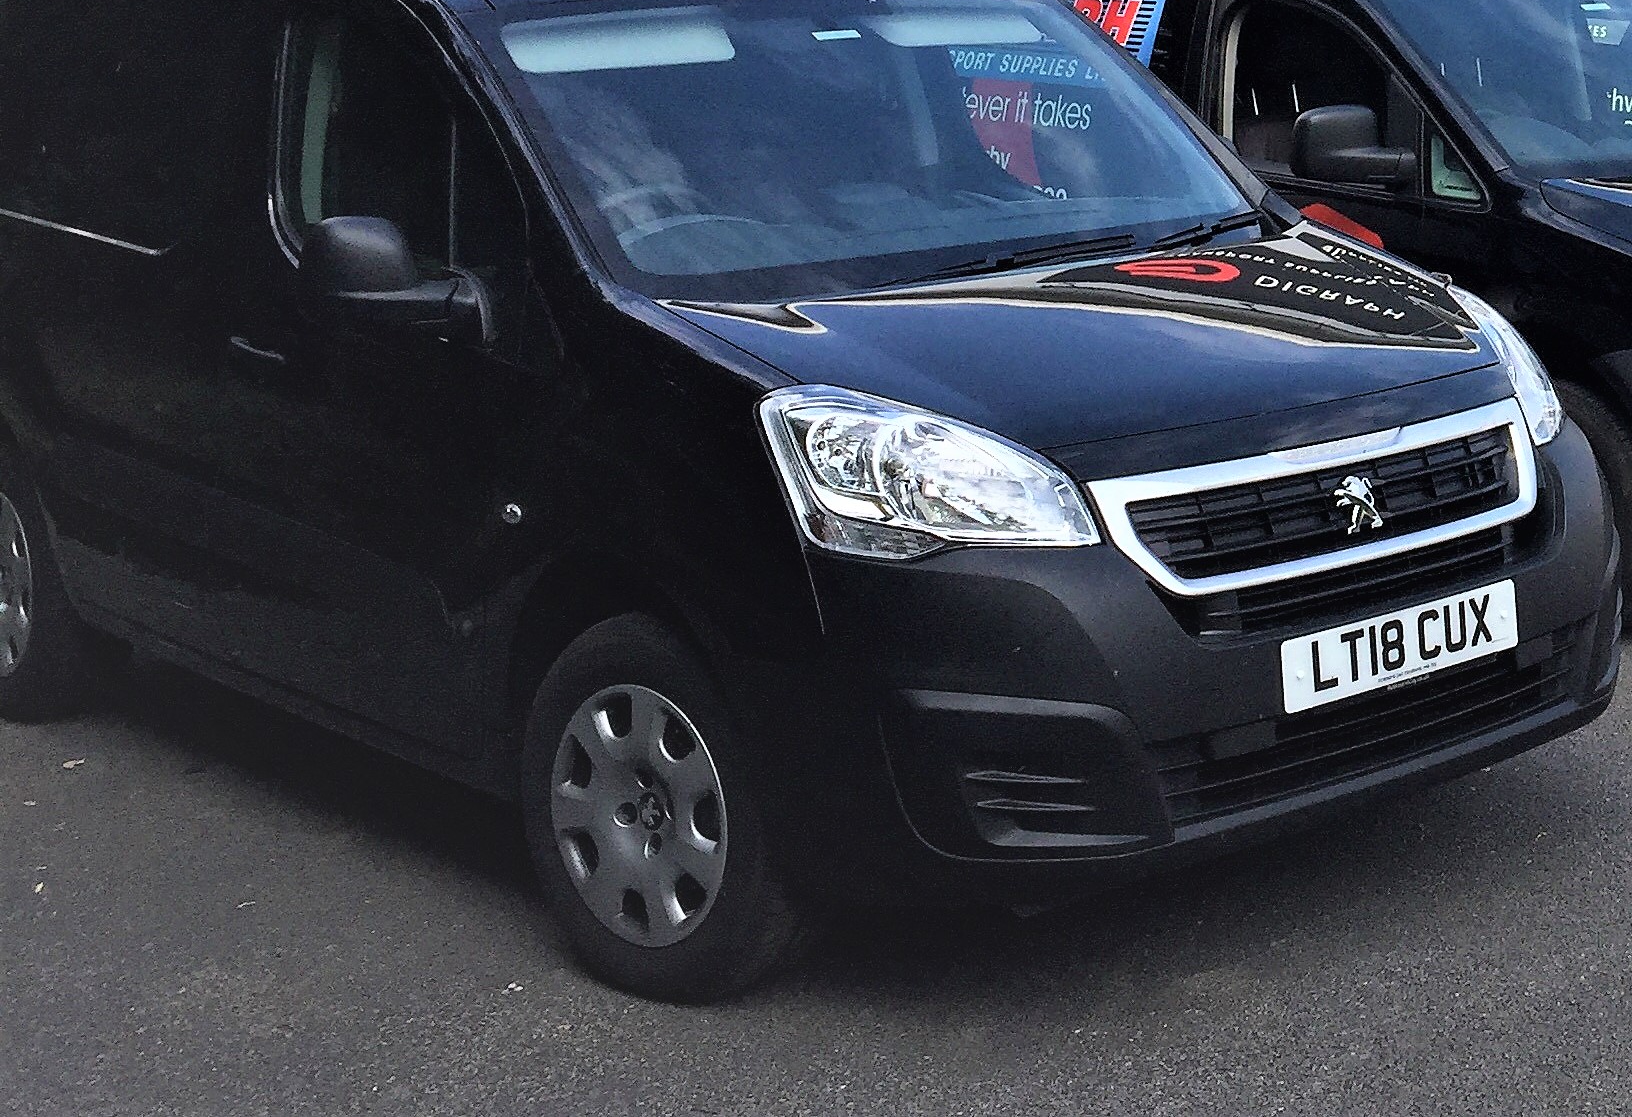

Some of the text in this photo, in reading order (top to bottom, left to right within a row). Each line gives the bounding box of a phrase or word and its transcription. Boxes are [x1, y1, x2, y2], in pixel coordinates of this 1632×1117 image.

[1000, 53, 1079, 78] SUPPLIES
[962, 86, 1092, 130] ever it takes
[1311, 593, 1493, 693] LT18 CUX
